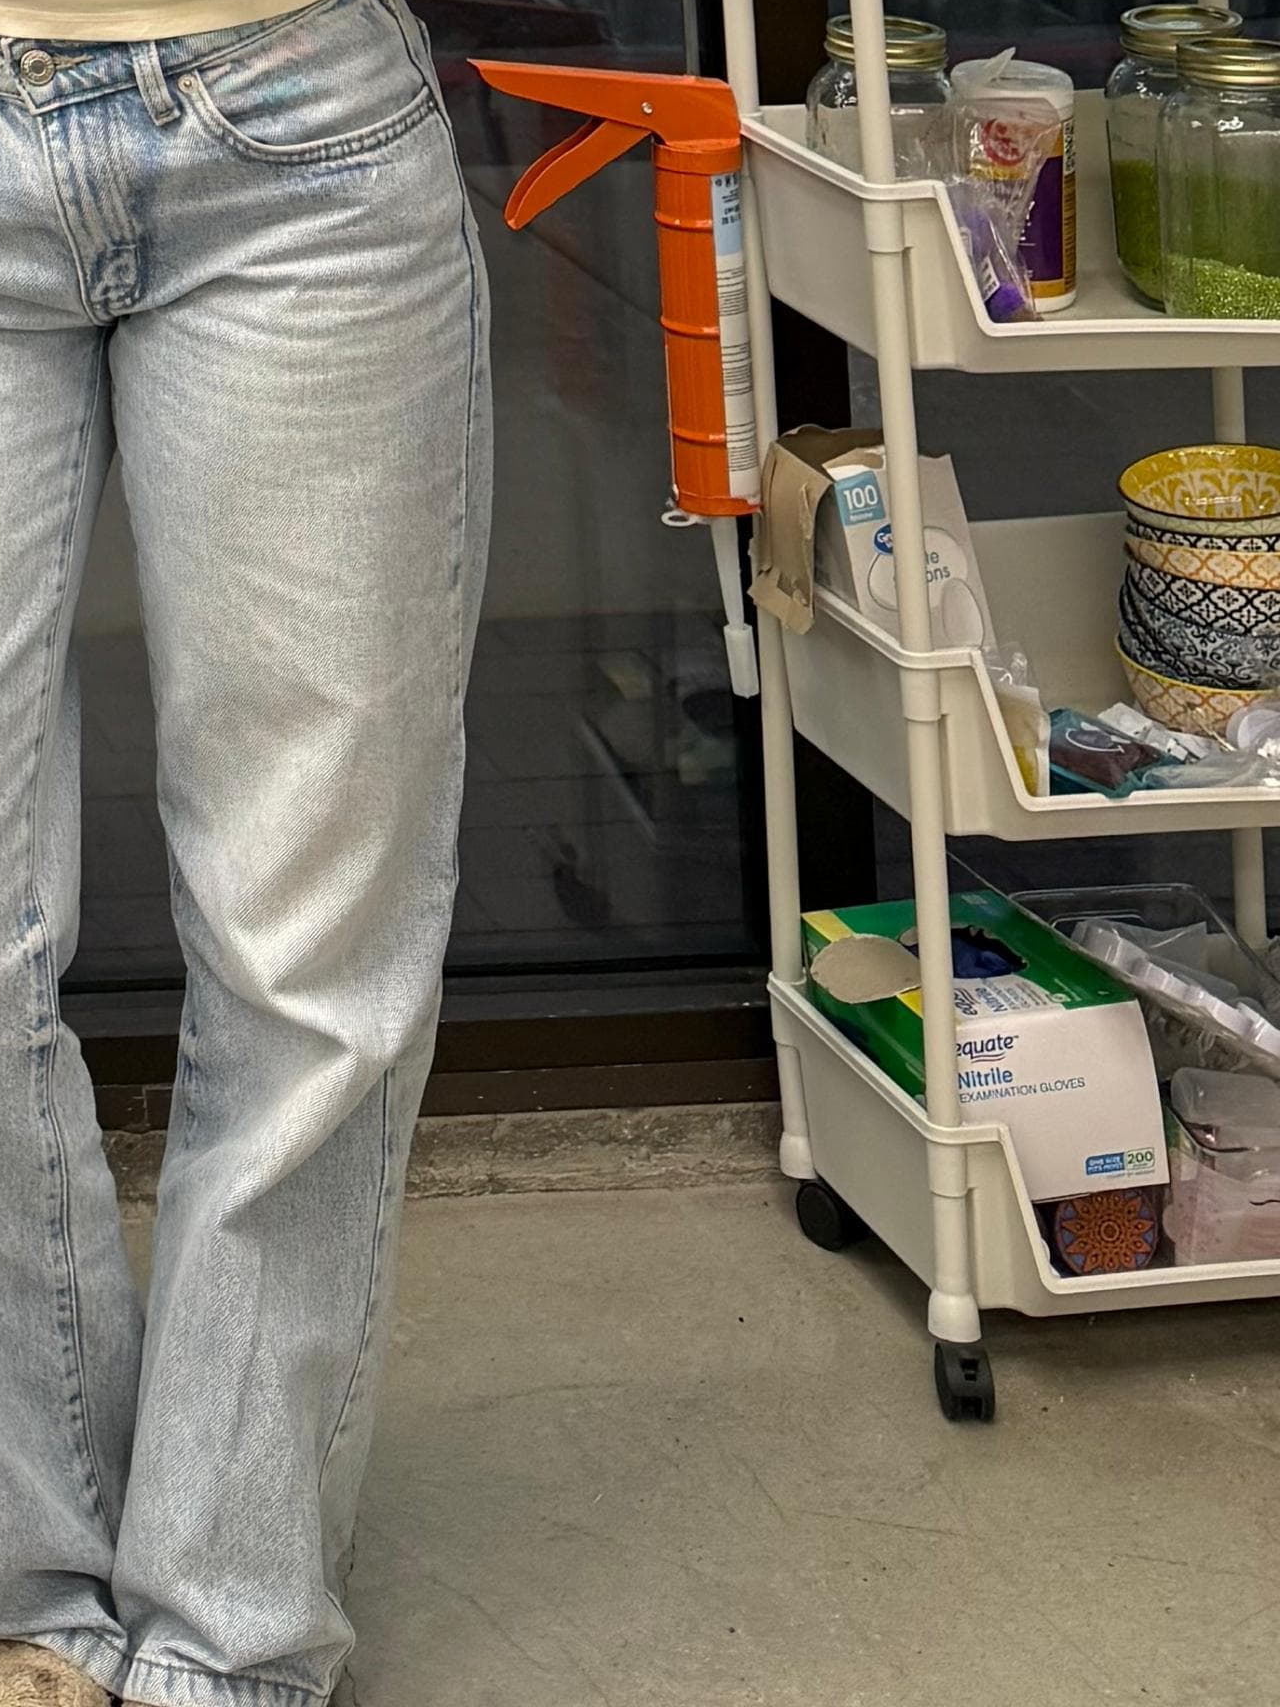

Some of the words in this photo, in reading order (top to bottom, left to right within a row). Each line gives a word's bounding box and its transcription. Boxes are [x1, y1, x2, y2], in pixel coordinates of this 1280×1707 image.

[843, 484, 878, 510] 100
[956, 1035, 1015, 1060] equate
[958, 1067, 1013, 1089] Nitrile
[959, 1085, 1038, 1104] EXAMINATION
[1039, 1077, 1086, 1094] GLOVES
[1127, 1150, 1154, 1165] 200
